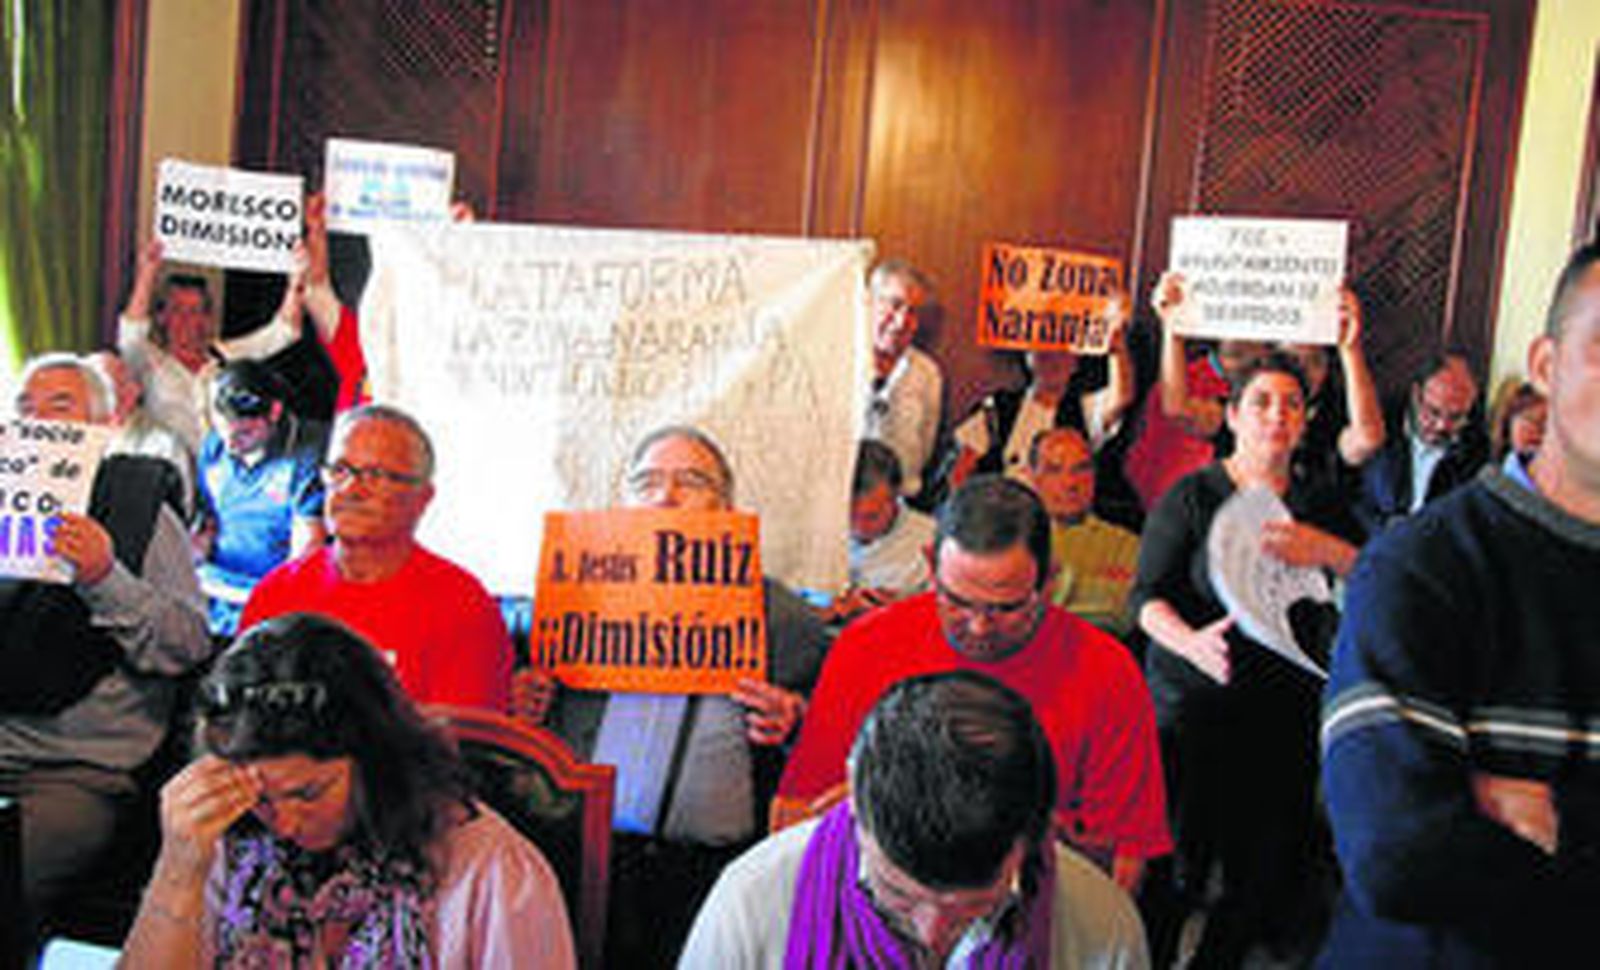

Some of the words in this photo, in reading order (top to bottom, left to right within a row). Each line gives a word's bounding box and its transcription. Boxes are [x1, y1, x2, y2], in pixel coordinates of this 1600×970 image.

[161, 184, 299, 222] MORESCO
[988, 249, 1027, 291] No
[1040, 254, 1117, 297] Zona
[985, 301, 1109, 349] Naranja
[51, 459, 81, 479] de
[655, 530, 753, 587] Ruiz
